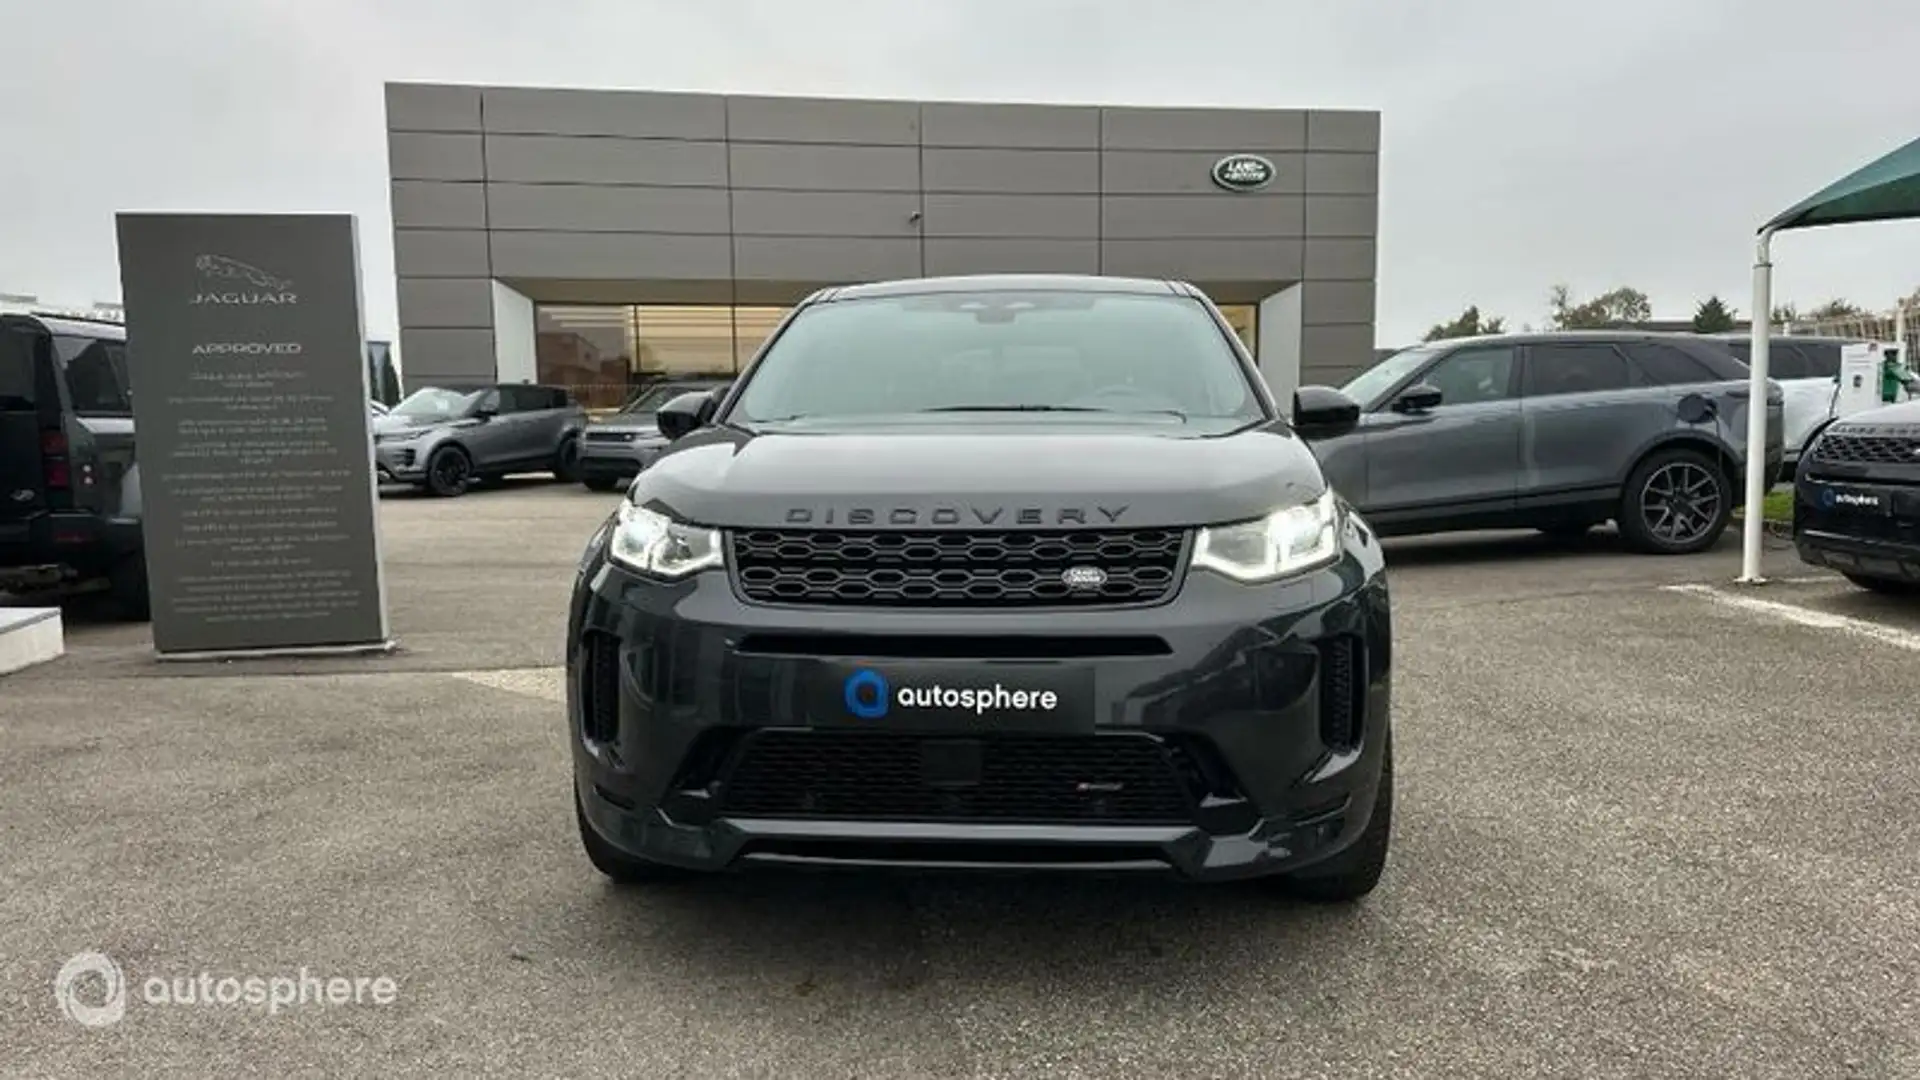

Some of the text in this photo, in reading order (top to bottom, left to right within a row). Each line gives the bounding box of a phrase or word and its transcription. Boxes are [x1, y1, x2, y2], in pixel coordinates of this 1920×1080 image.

[190, 292, 297, 304] JAGUAR
[192, 342, 302, 355] APPROVED
[785, 504, 1131, 525] DISCOVERY
